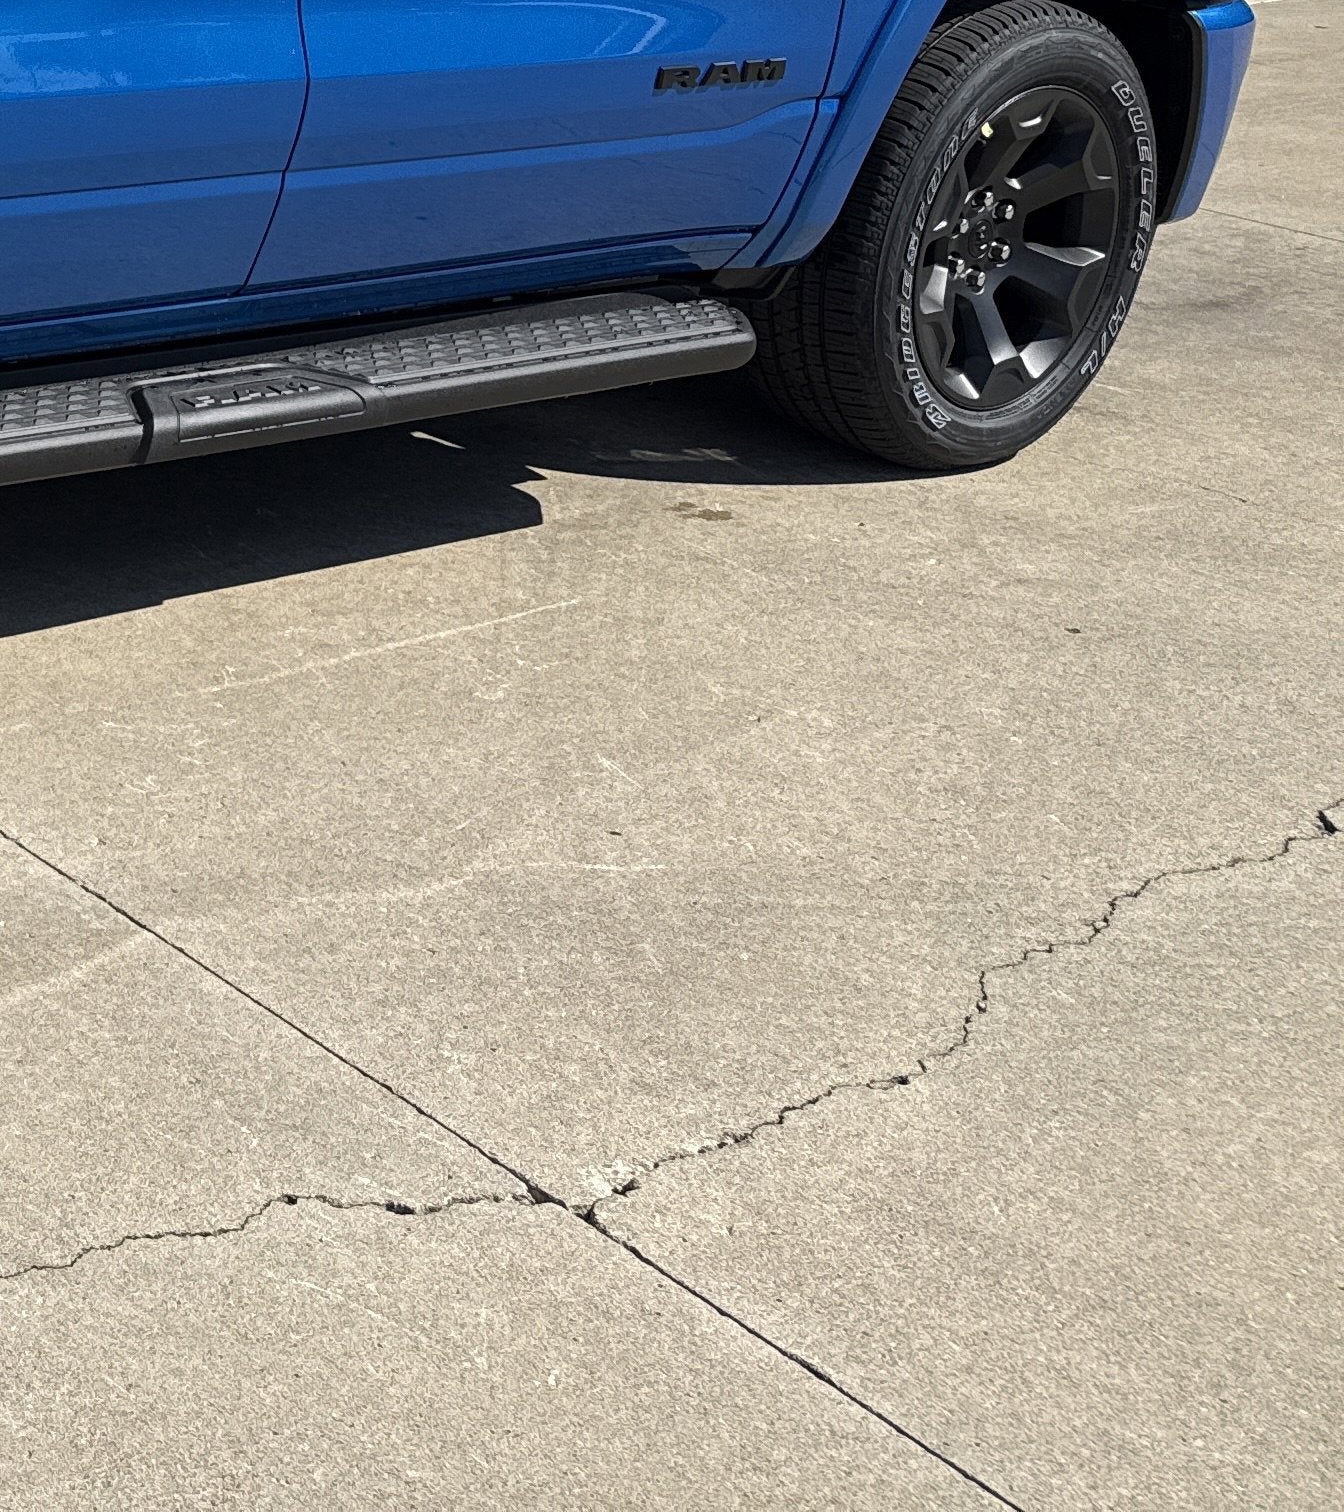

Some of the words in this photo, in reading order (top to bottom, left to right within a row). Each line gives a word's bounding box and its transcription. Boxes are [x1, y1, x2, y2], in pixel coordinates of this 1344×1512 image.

[653, 57, 788, 90] RAM
[1111, 79, 1154, 274] DUELER
[901, 106, 979, 430] BRIDGESTONE
[1080, 295, 1127, 376] H/L
